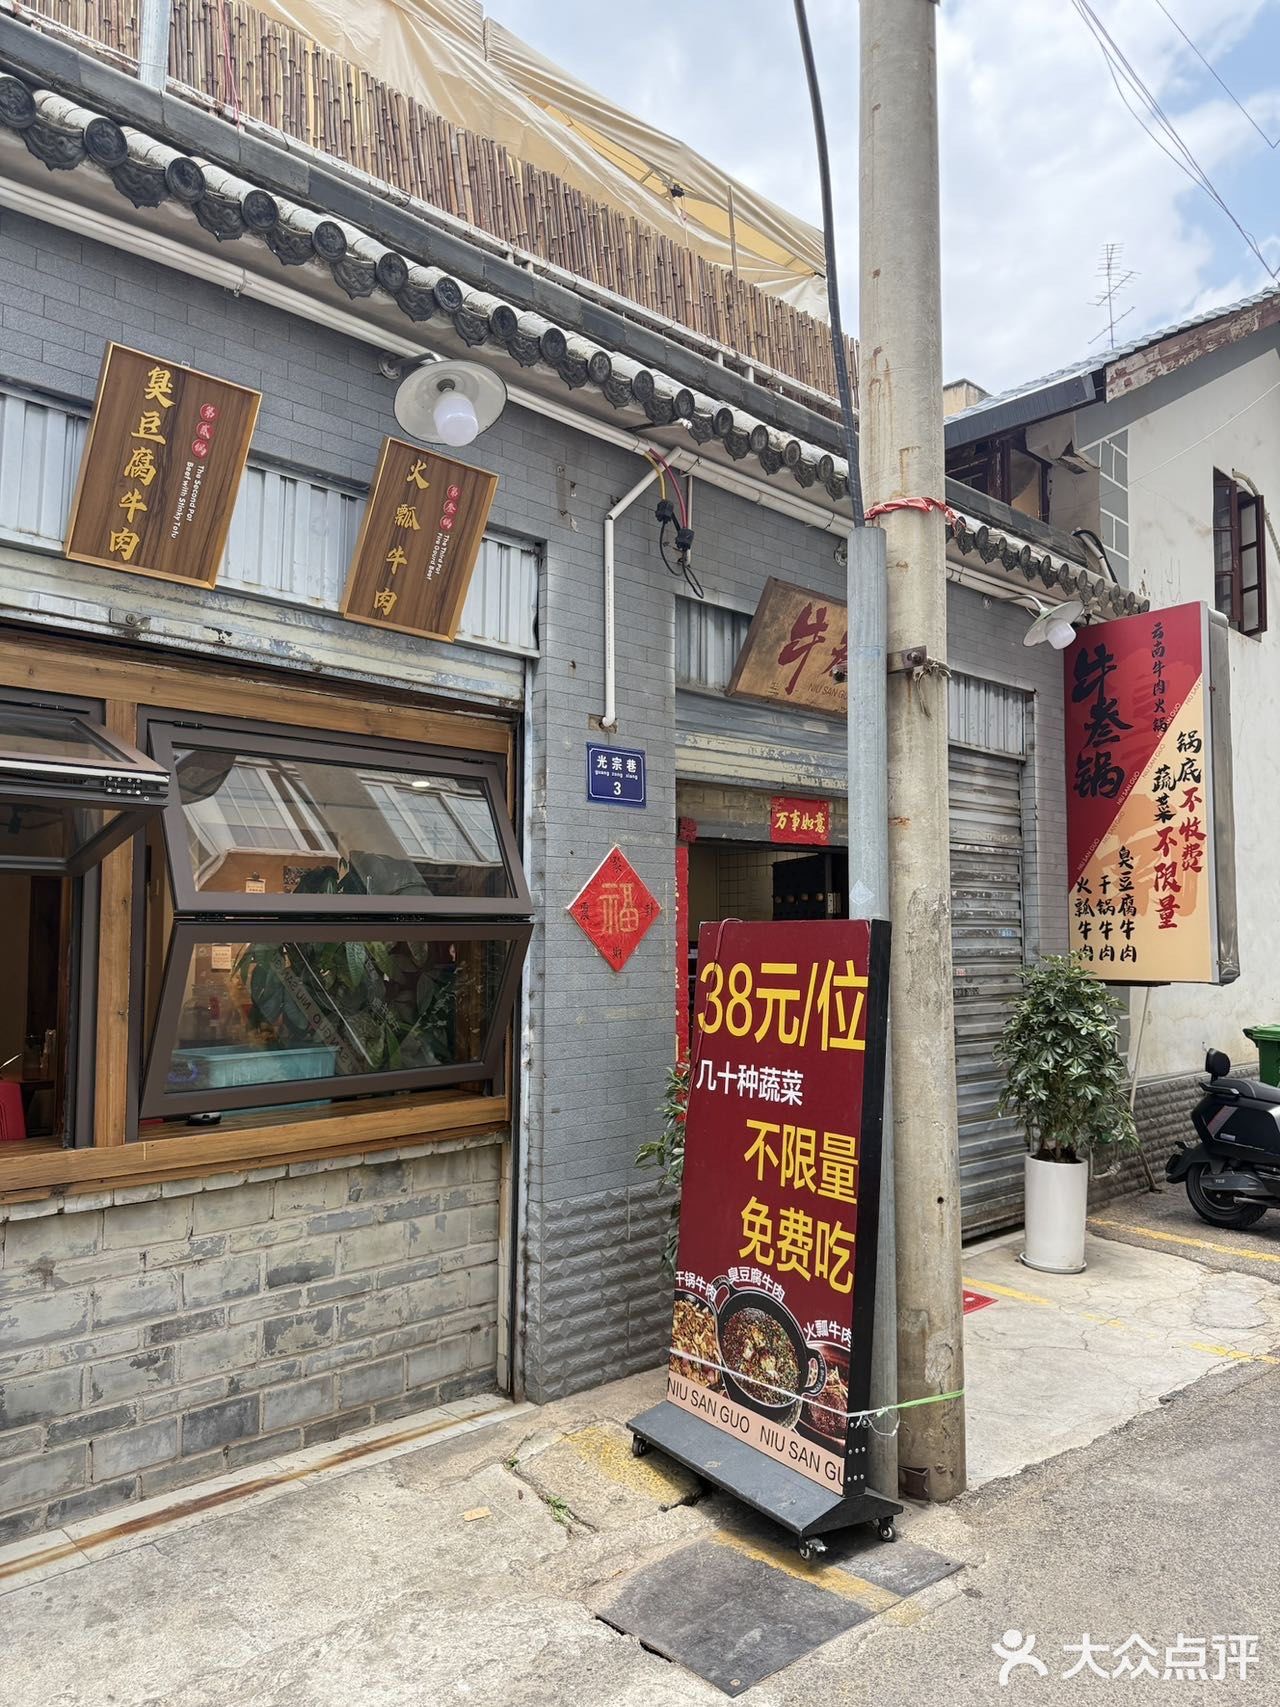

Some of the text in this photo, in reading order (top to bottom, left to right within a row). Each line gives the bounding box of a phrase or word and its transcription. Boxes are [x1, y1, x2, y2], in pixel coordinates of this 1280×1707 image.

[110, 366, 176, 561] 臭豆腐牛肉
[170, 461, 195, 539] Beef with Stinky Tofu
[186, 464, 205, 522] The Second Pot
[373, 459, 430, 616] 火瓢牛肉
[808, 684, 822, 694] NIU
[822, 687, 838, 697] SAN
[1151, 621, 1169, 733] 云南牛肉火锅
[597, 755, 637, 773] 光宗巷
[1072, 643, 1134, 799] 牛叁锅
[613, 781, 622, 796] 3
[774, 809, 826, 833] 万事如意
[1176, 729, 1207, 873] 锅底不收费
[1152, 764, 1182, 930] 蔬菜不限量
[1074, 876, 1095, 962] 火瓢牛肉
[1096, 875, 1116, 962] 干锅牛肉
[1117, 846, 1137, 962] 臭豆腐牛肉
[698, 959, 869, 1051] 38元/位
[696, 1059, 804, 1106] 几十种蔬菜
[743, 1119, 859, 1204] 不限量
[675, 1270, 717, 1302] 干锅牛肉
[728, 1266, 786, 1302] 臭豆腐牛肉
[738, 1196, 856, 1294] 免费吃
[667, 1377, 688, 1401] NIU
[690, 1389, 717, 1417] SAN
[719, 1405, 750, 1434] GUO
[760, 1425, 785, 1453] NIU
[788, 1441, 821, 1473] SAN
